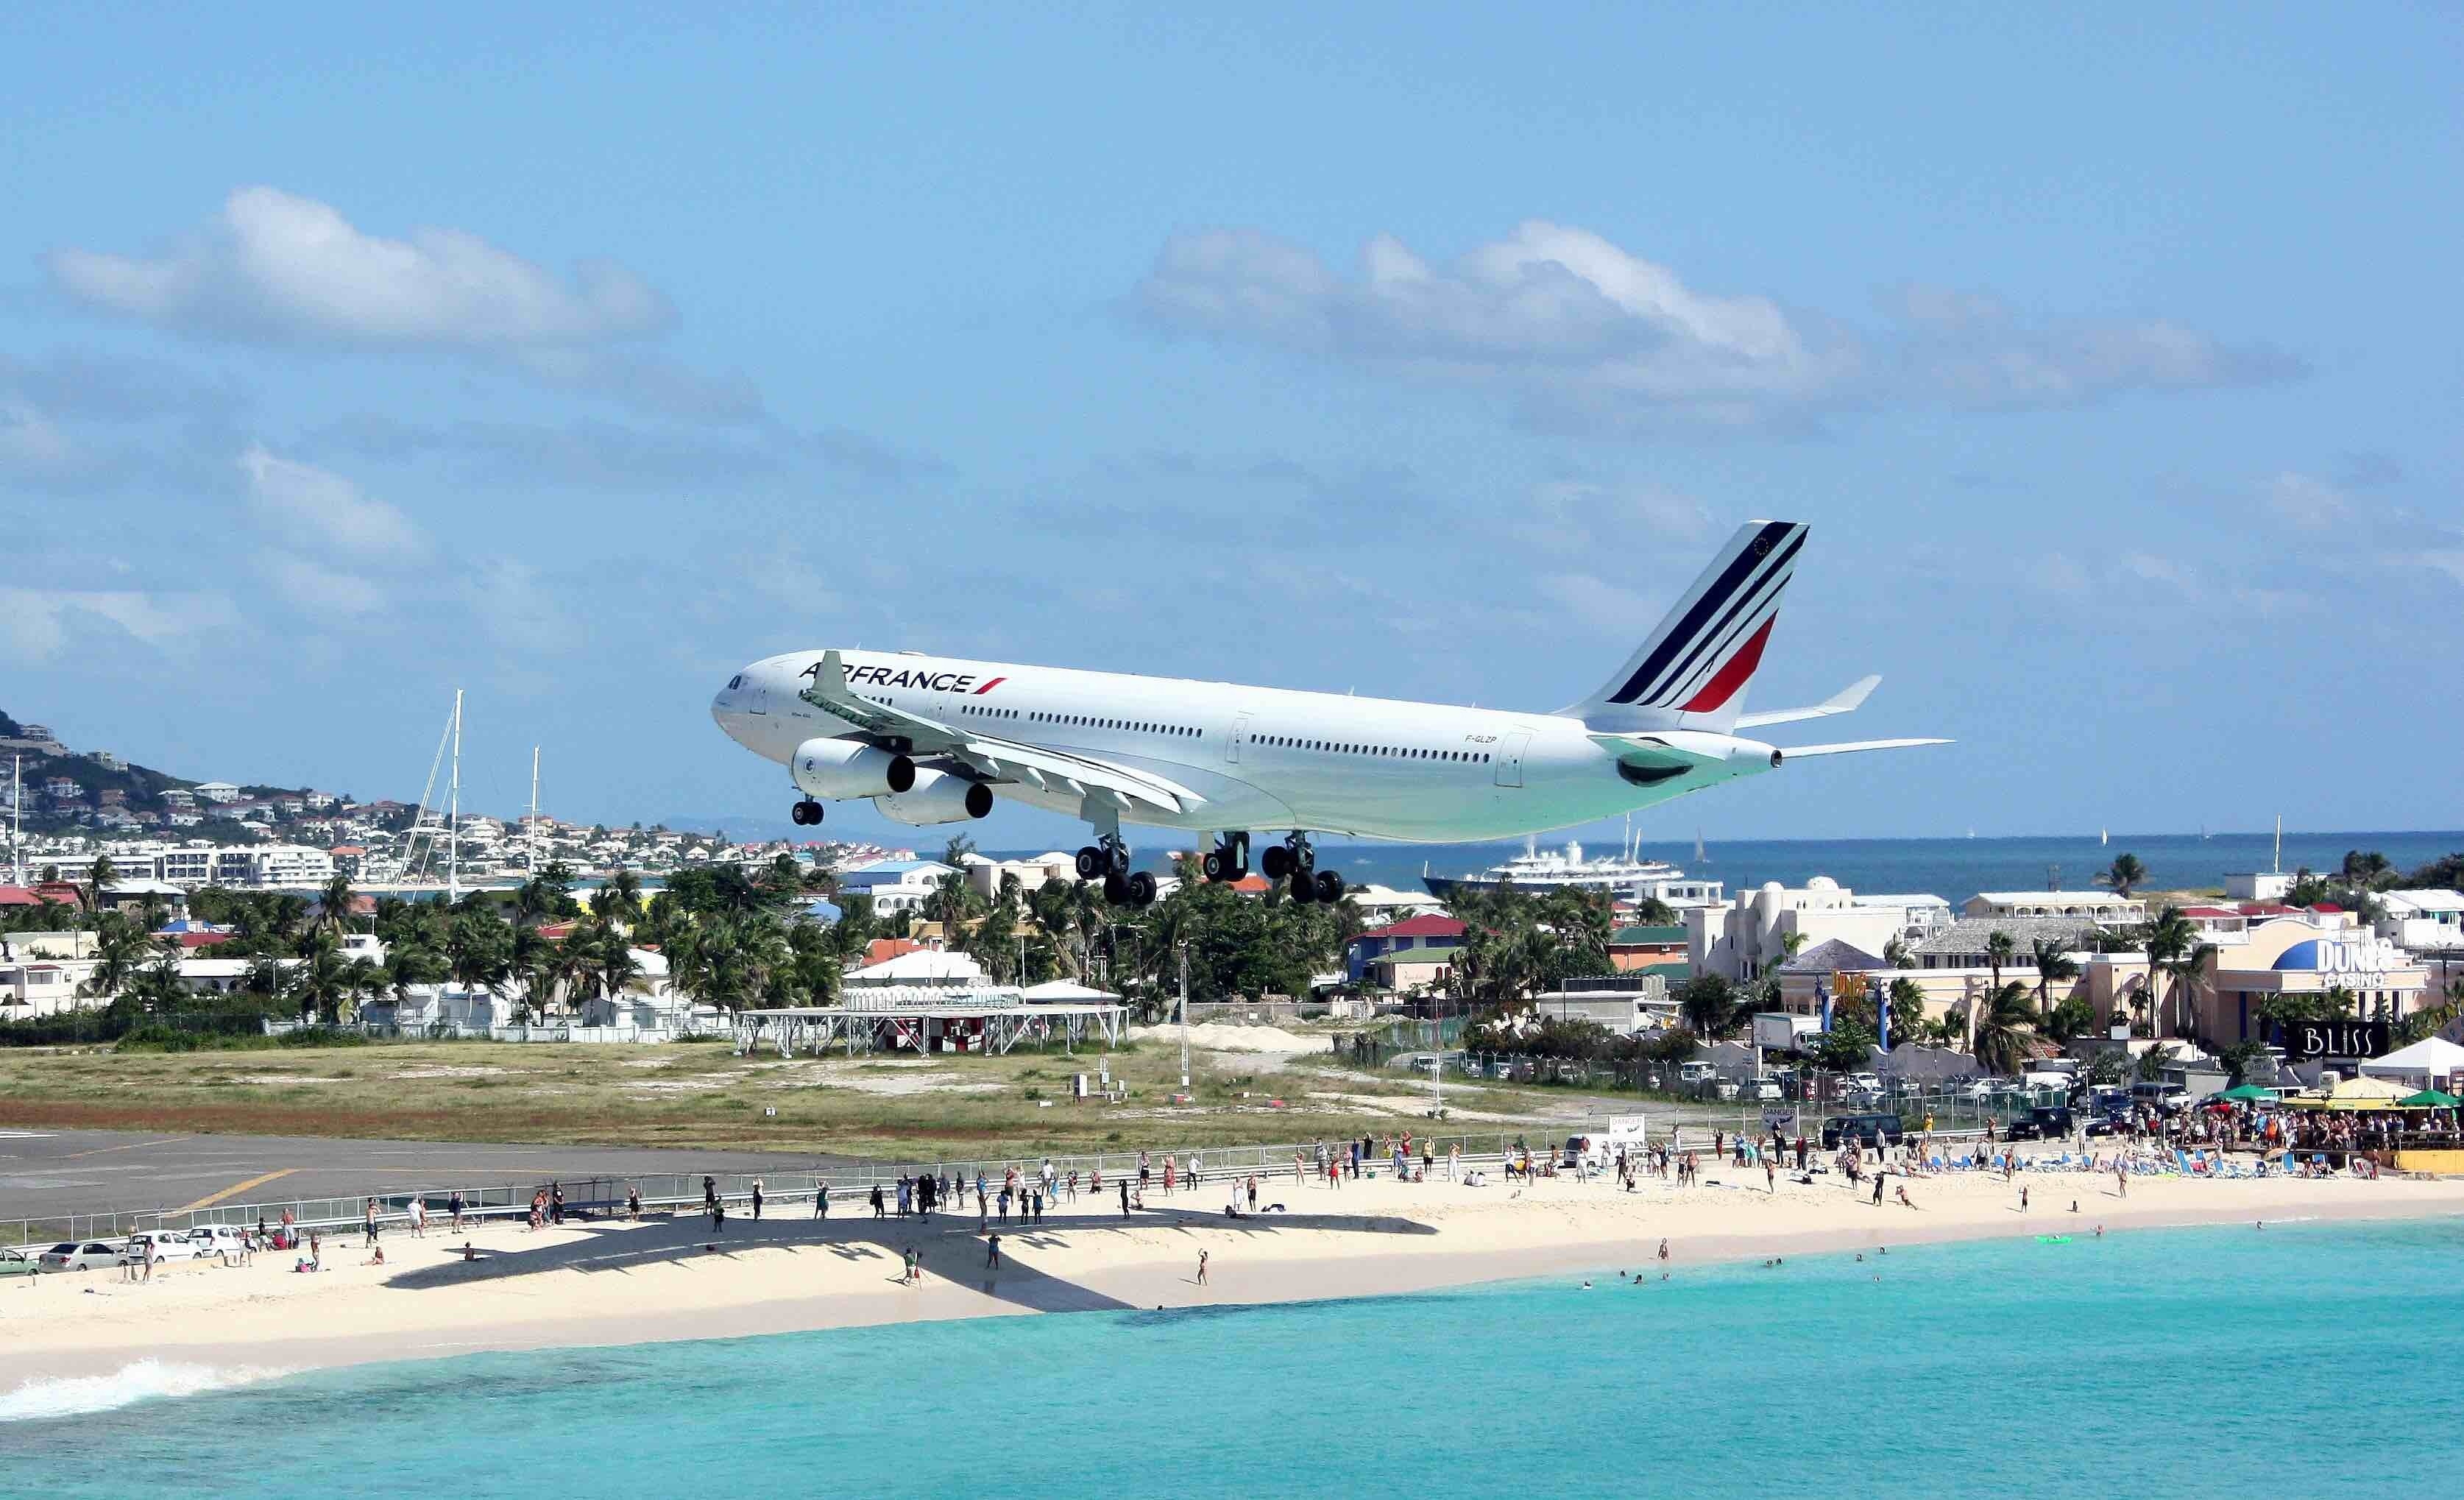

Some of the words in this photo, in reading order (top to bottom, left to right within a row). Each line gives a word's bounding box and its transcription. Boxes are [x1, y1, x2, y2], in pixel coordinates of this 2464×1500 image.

[799, 662, 978, 693] ARFRANCE
[1465, 735, 1497, 743] F-GLZP
[2324, 972, 2385, 988] CASINO
[2303, 1023, 2372, 1055] BLISS
[1763, 1108, 1796, 1116] DANGER
[1612, 1117, 1643, 1125] DANGER
